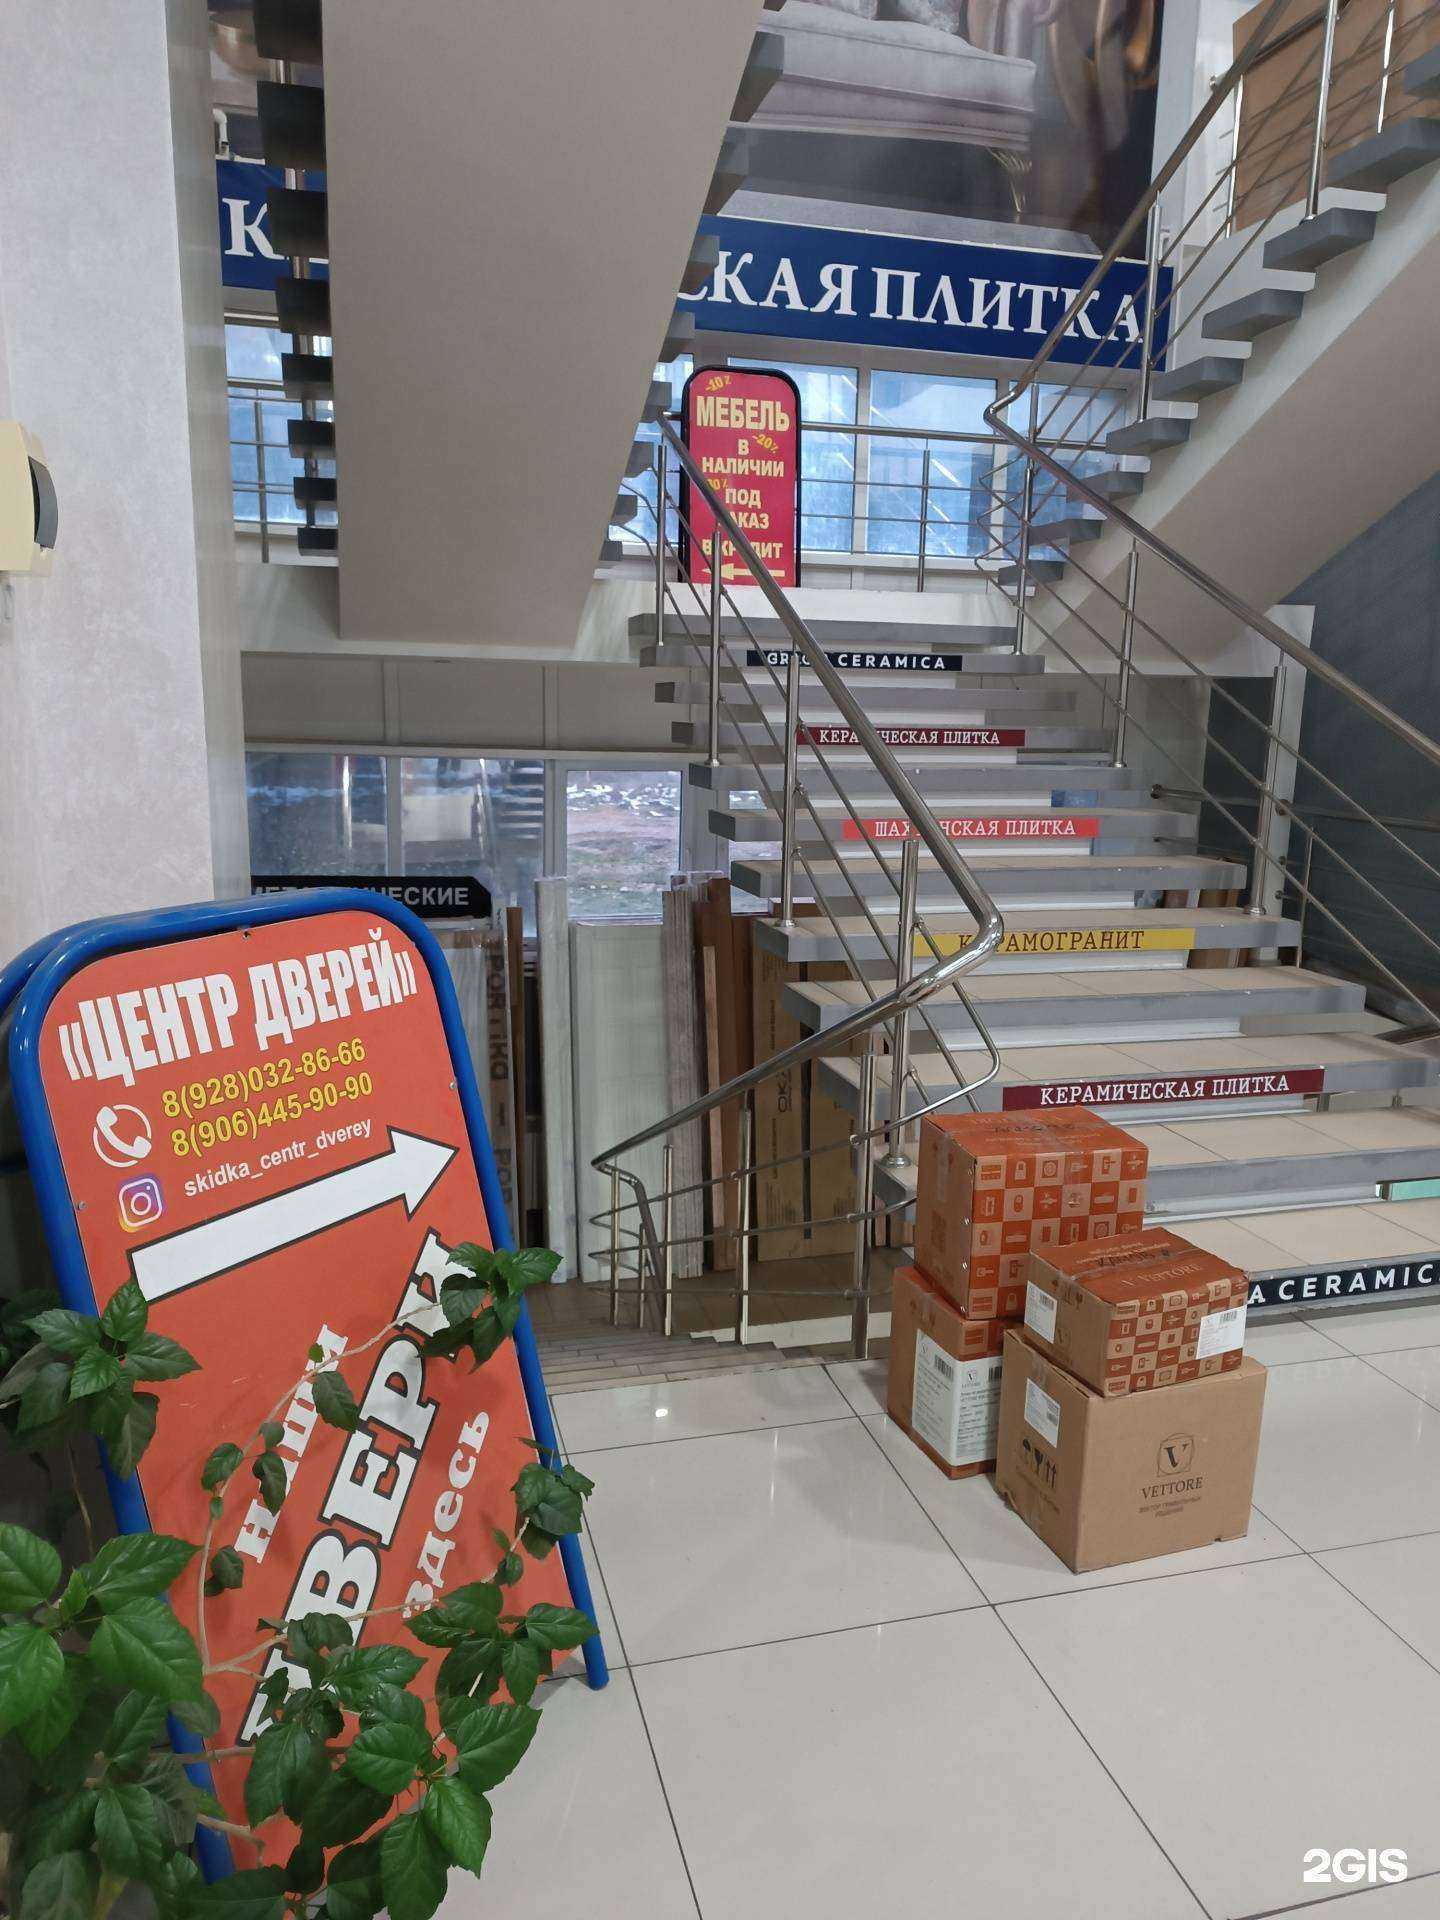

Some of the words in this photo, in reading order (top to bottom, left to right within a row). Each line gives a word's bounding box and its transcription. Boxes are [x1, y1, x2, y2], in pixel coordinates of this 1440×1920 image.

[870, 266, 1144, 344] ПЛИТКА
[696, 395, 790, 431] МЕБЕЛЬ
[738, 439, 750, 455] В
[702, 457, 784, 477] НАЛИЧИИ
[725, 488, 762, 509] ПОД
[838, 653, 946, 669] CERAMICA
[820, 729, 939, 745] КЕРАЧЕСКАЯ
[943, 731, 1000, 745] ПЛИТКА
[1005, 820, 1076, 836] ПЛИТКА
[161, 1037, 367, 1119] 8(928)032-86-66
[1040, 1079, 1205, 1106] КЕРАМИЧЕСКАЯ
[1212, 1074, 1290, 1097] ПЛИТКА
[171, 1071, 373, 1157] 8(906)445-90-90
[183, 1118, 372, 1198] skidka_centr_dverey
[1278, 1263, 1440, 1301] CERAMIC
[1141, 1477, 1204, 1499] VETTORE
